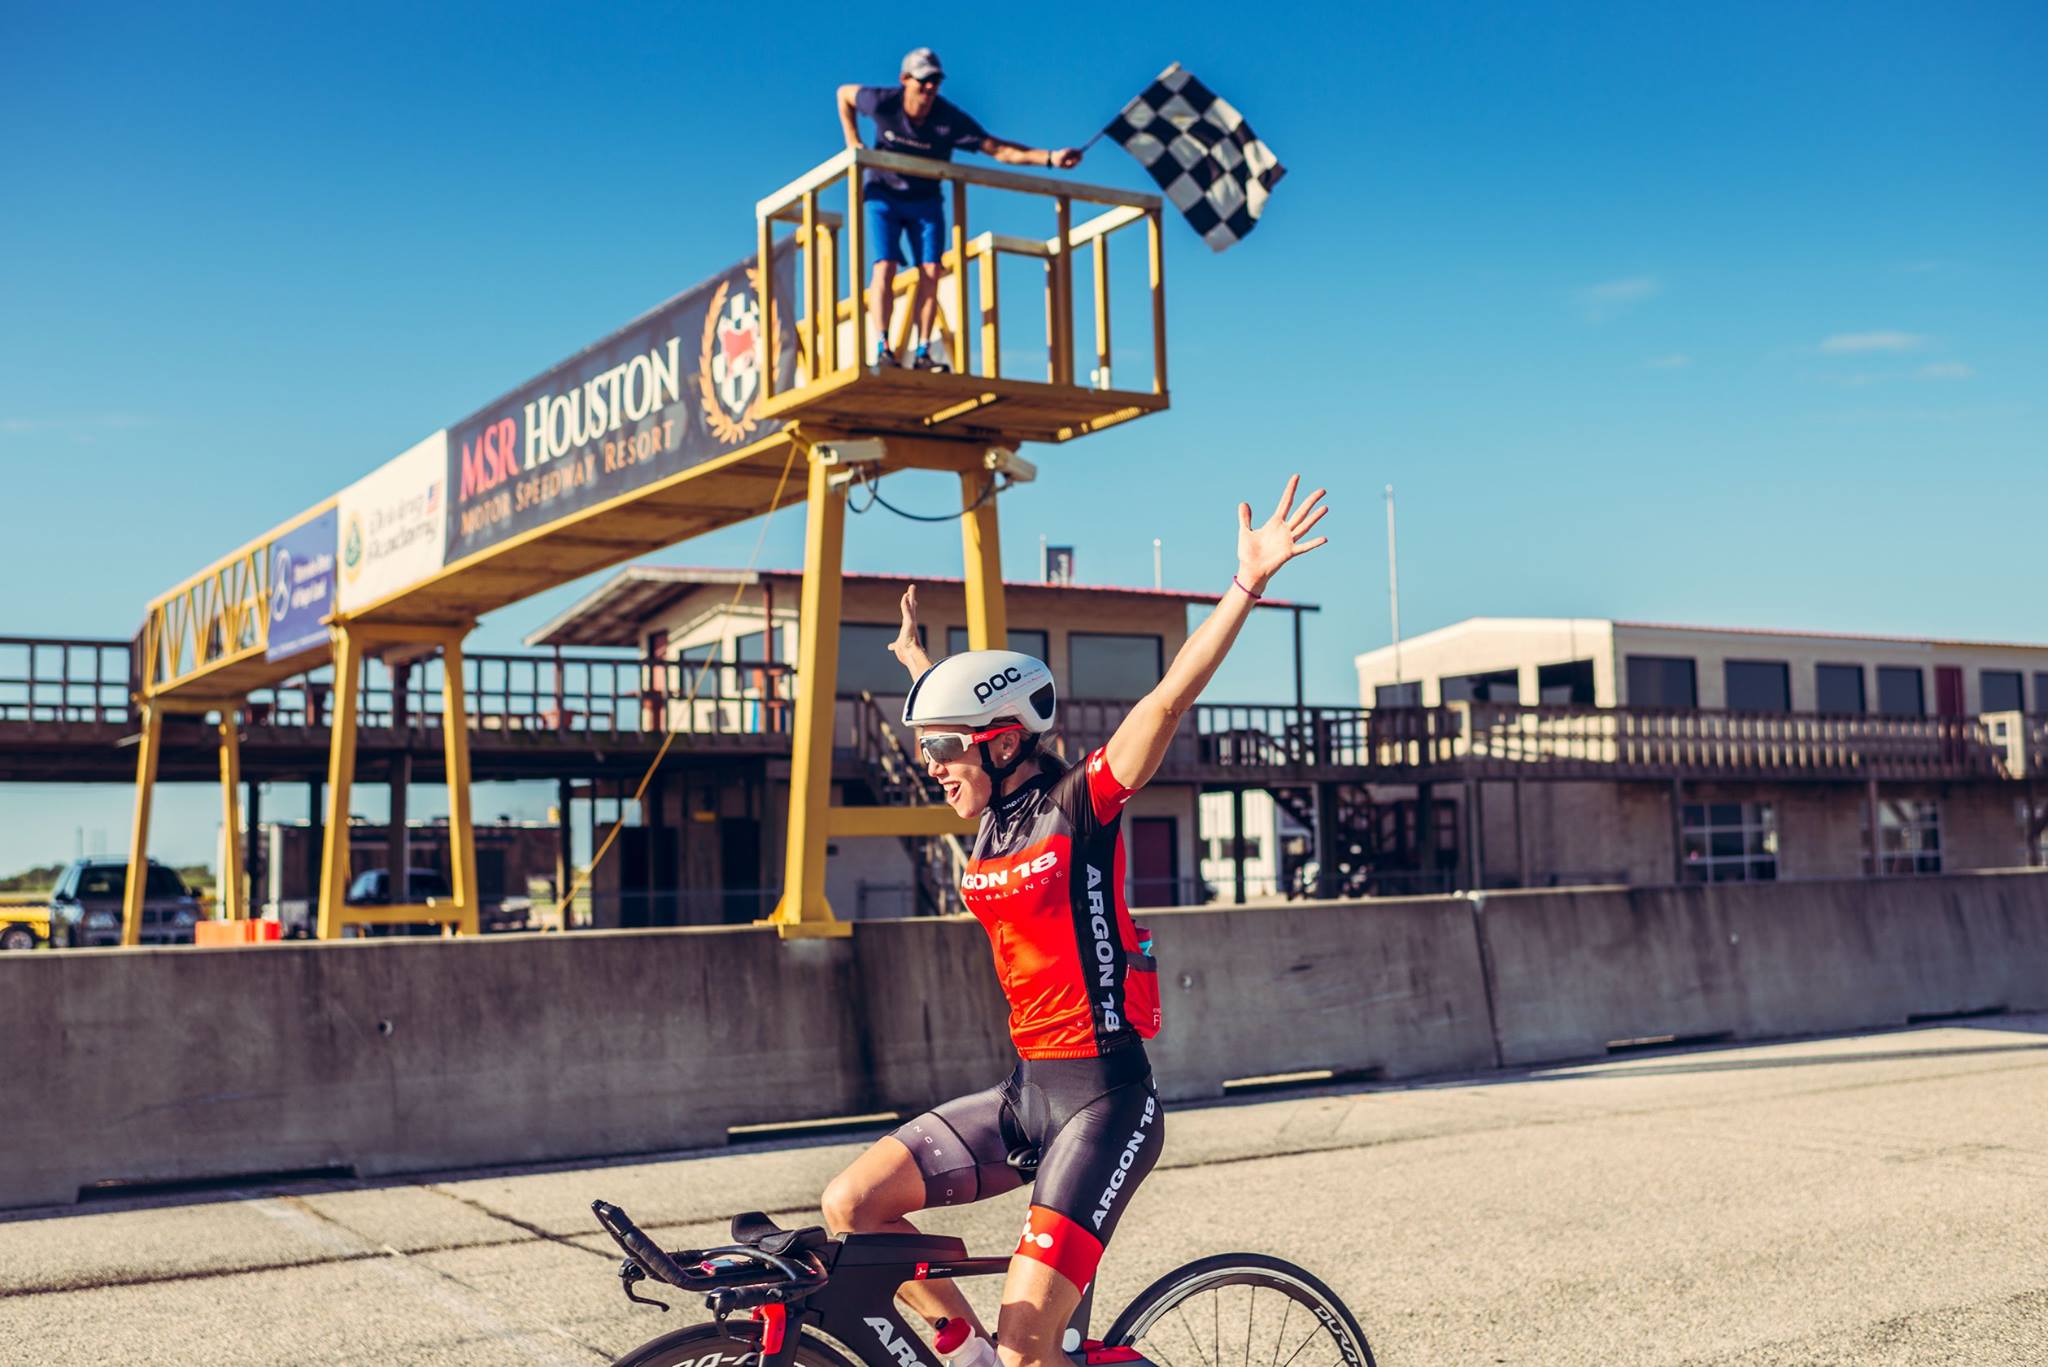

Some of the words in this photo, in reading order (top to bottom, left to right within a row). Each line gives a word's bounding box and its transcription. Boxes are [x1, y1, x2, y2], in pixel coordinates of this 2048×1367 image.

[460, 417, 519, 502] MSR
[523, 337, 681, 471] HOUSTON
[461, 493, 511, 536] MOTOR
[515, 454, 595, 512] SPEEDWAY
[604, 420, 674, 473] RESORT
[962, 870, 1008, 890] GON
[1012, 851, 1058, 879] 18
[985, 870, 1063, 901] BALANCE
[1087, 864, 1114, 987] ARGON
[1101, 993, 1120, 1032] 18
[1092, 1130, 1146, 1231] ARGON
[1140, 1096, 1155, 1127] 18
